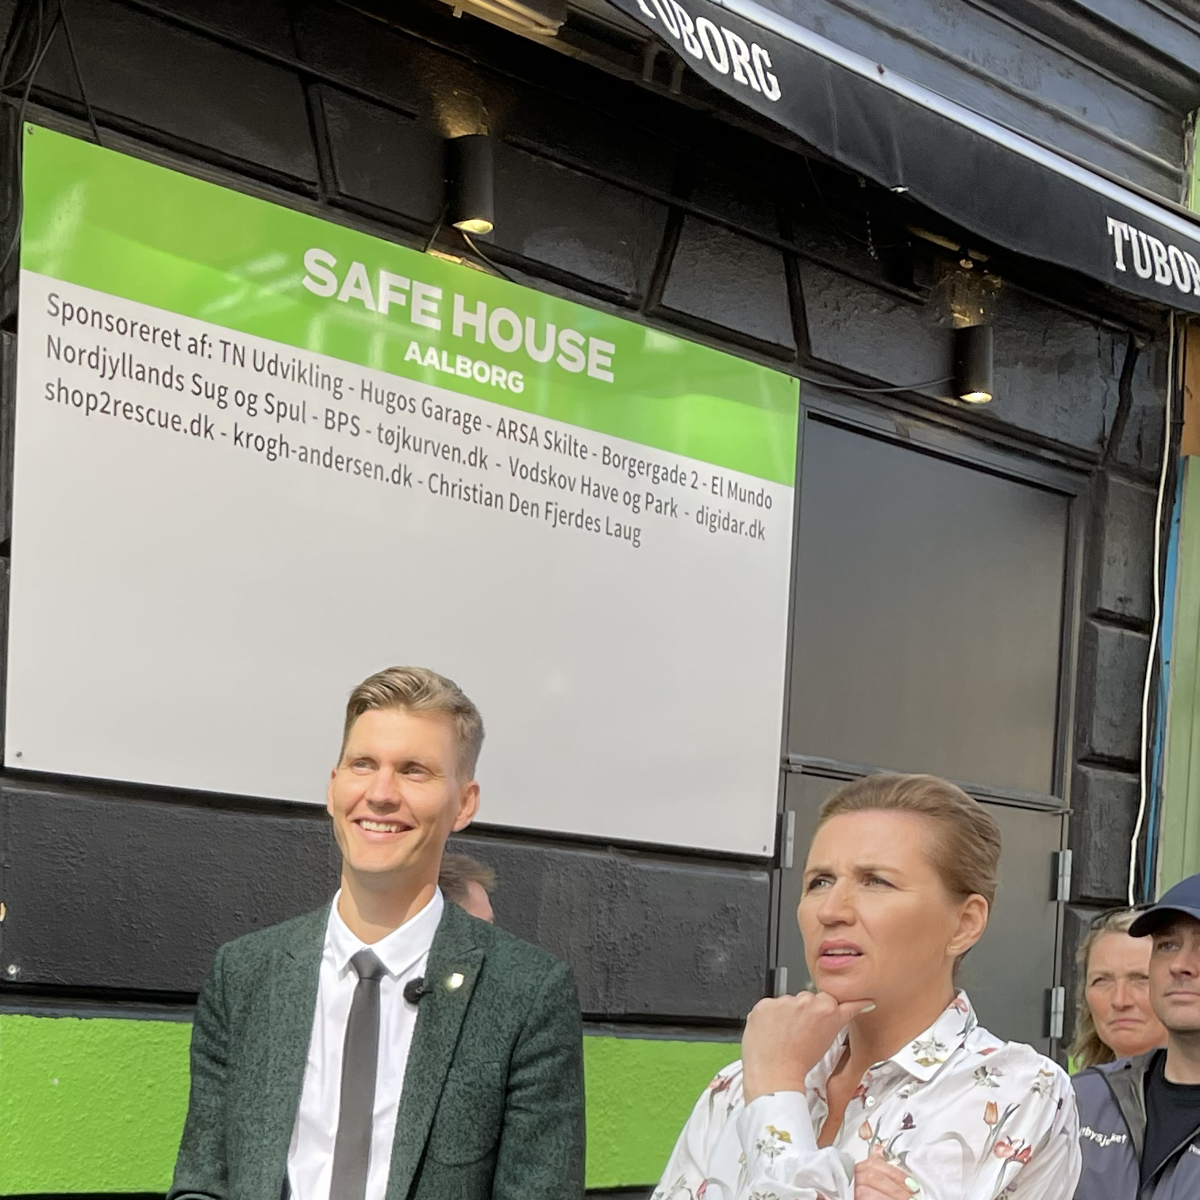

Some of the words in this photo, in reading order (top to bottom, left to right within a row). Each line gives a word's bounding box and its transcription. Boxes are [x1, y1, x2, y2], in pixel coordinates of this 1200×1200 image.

[47, 292, 182, 352] Sponsoreret
[187, 333, 213, 360] af:
[218, 339, 246, 369] TN
[252, 348, 344, 401] Udvikling
[360, 378, 417, 415] Hugos
[421, 396, 482, 435] Garage
[495, 417, 540, 448] ARSA
[543, 429, 589, 461] Skilte
[601, 445, 687, 488] Borgergade
[690, 470, 699, 491] 2
[711, 475, 724, 497] El
[727, 479, 773, 510] Mundo
[302, 247, 443, 332] SAFE
[452, 293, 616, 384] HOUSE
[403, 341, 525, 393] AALBORG
[44, 377, 215, 441] shop2rescue.dk
[233, 421, 413, 489] krogh-andersen.dk
[427, 472, 504, 511] Christian
[509, 491, 540, 519] Den
[544, 500, 601, 533] Fjerdes
[605, 515, 642, 549] Laug
[47, 334, 185, 393] Nordjyllands
[190, 372, 229, 410] Sug
[233, 389, 259, 418] og
[263, 391, 307, 425] Spul
[324, 407, 361, 437] BPS
[376, 422, 489, 471] tøjkurven.dk
[509, 455, 577, 493] Vodskov
[580, 474, 619, 503] Have
[622, 490, 642, 515] og
[645, 491, 679, 519] Park
[695, 504, 766, 541] digidar.dk
